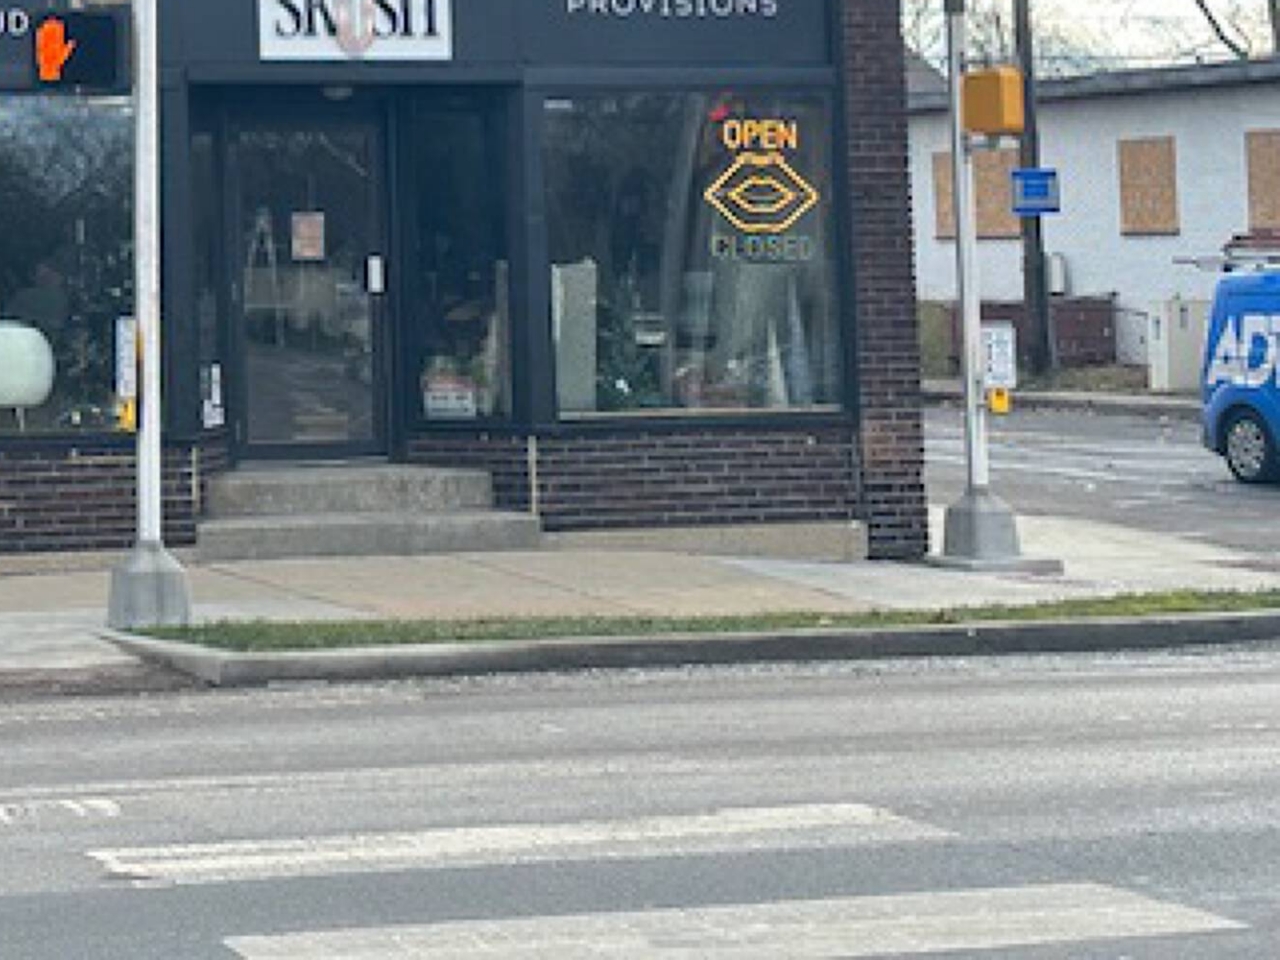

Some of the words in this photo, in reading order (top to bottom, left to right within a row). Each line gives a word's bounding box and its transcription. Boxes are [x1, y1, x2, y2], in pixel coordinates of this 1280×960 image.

[723, 119, 797, 149] OPEN
[712, 235, 813, 261] CLOSED
[1207, 314, 1280, 388] AD
